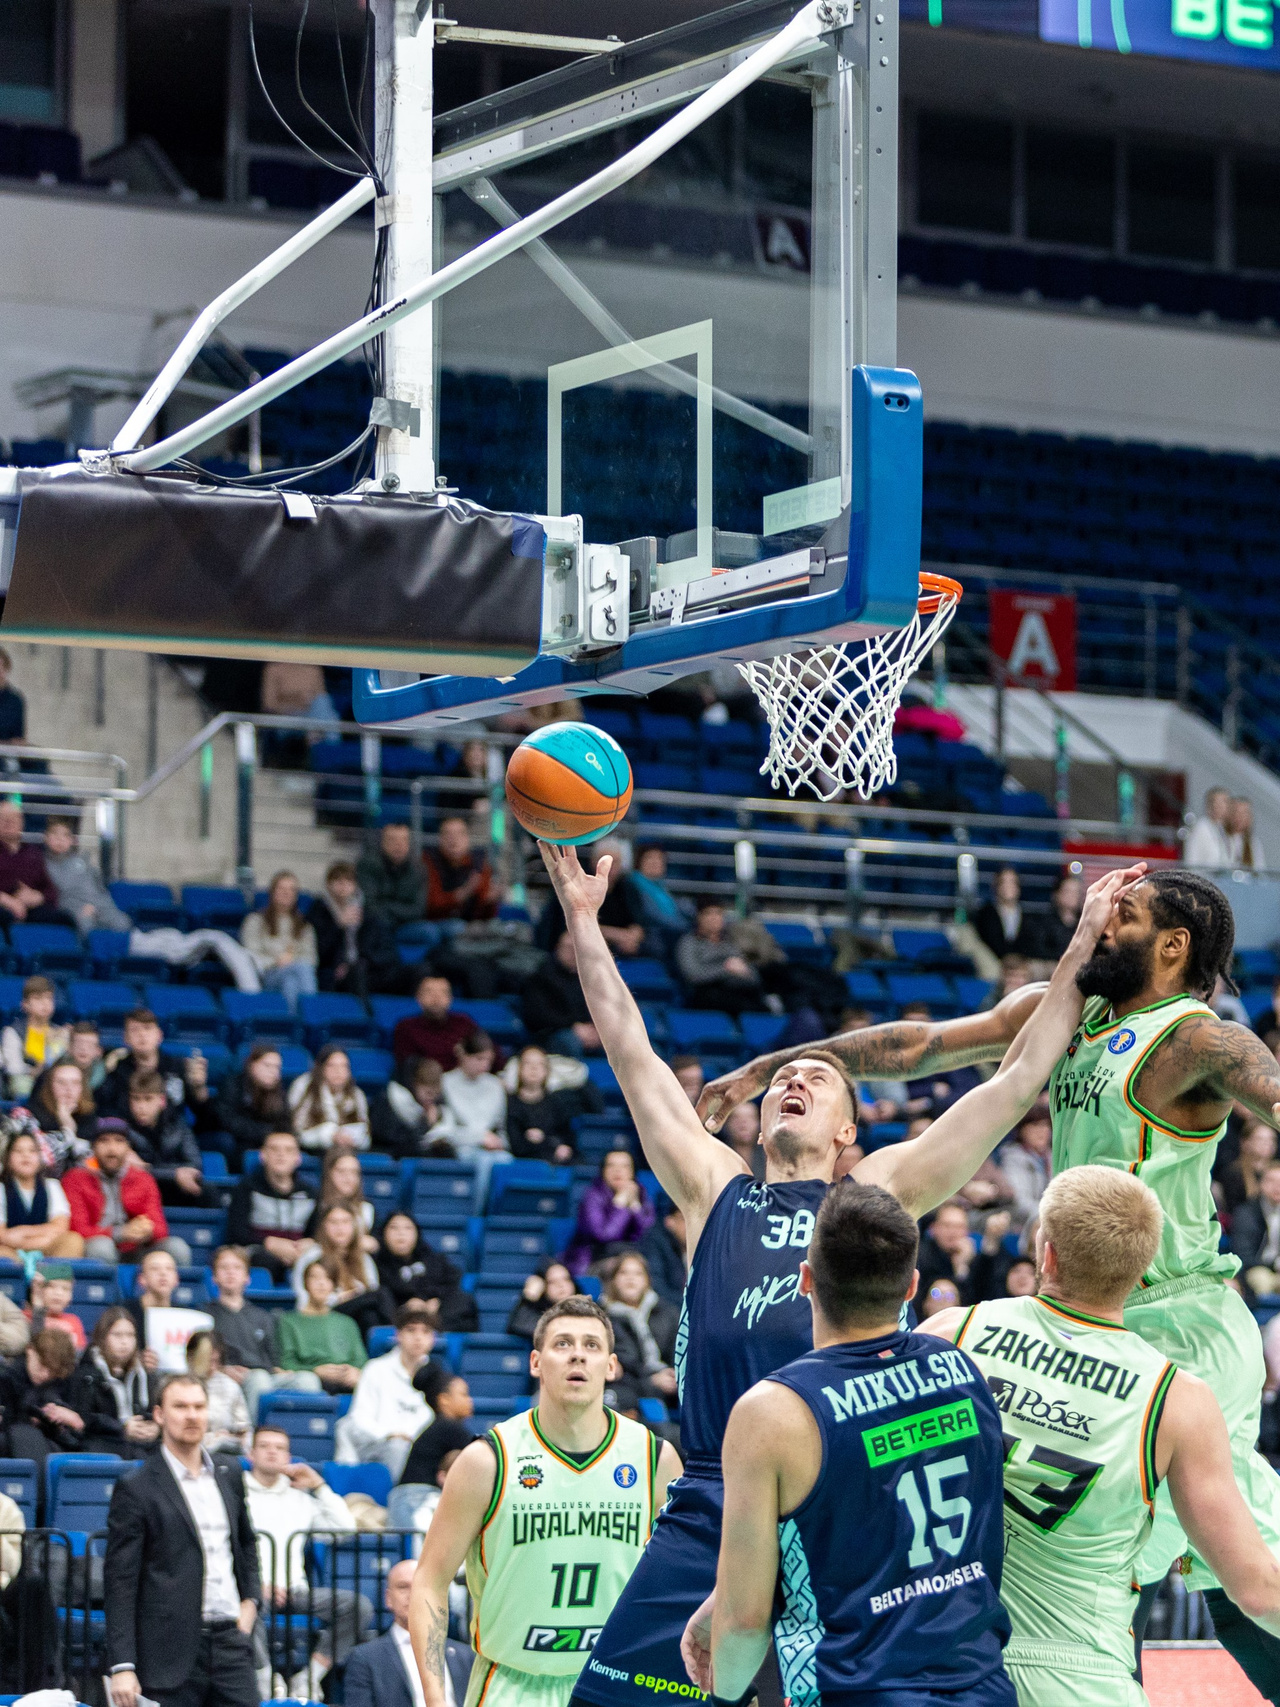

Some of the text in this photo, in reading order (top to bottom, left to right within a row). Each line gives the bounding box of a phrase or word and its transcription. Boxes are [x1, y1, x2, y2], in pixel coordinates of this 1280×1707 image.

[1008, 610, 1061, 676] A
[761, 1208, 816, 1249] 38
[972, 1325, 1141, 1401] ZAKHAROV
[821, 1350, 976, 1423] MIKULSKI
[512, 1502, 642, 1511] SVERDLOVSK REGION
[512, 1511, 641, 1547] URALMASH
[896, 1455, 972, 1568] 15
[551, 1563, 601, 1608] 10
[589, 1658, 629, 1681] Kempa
